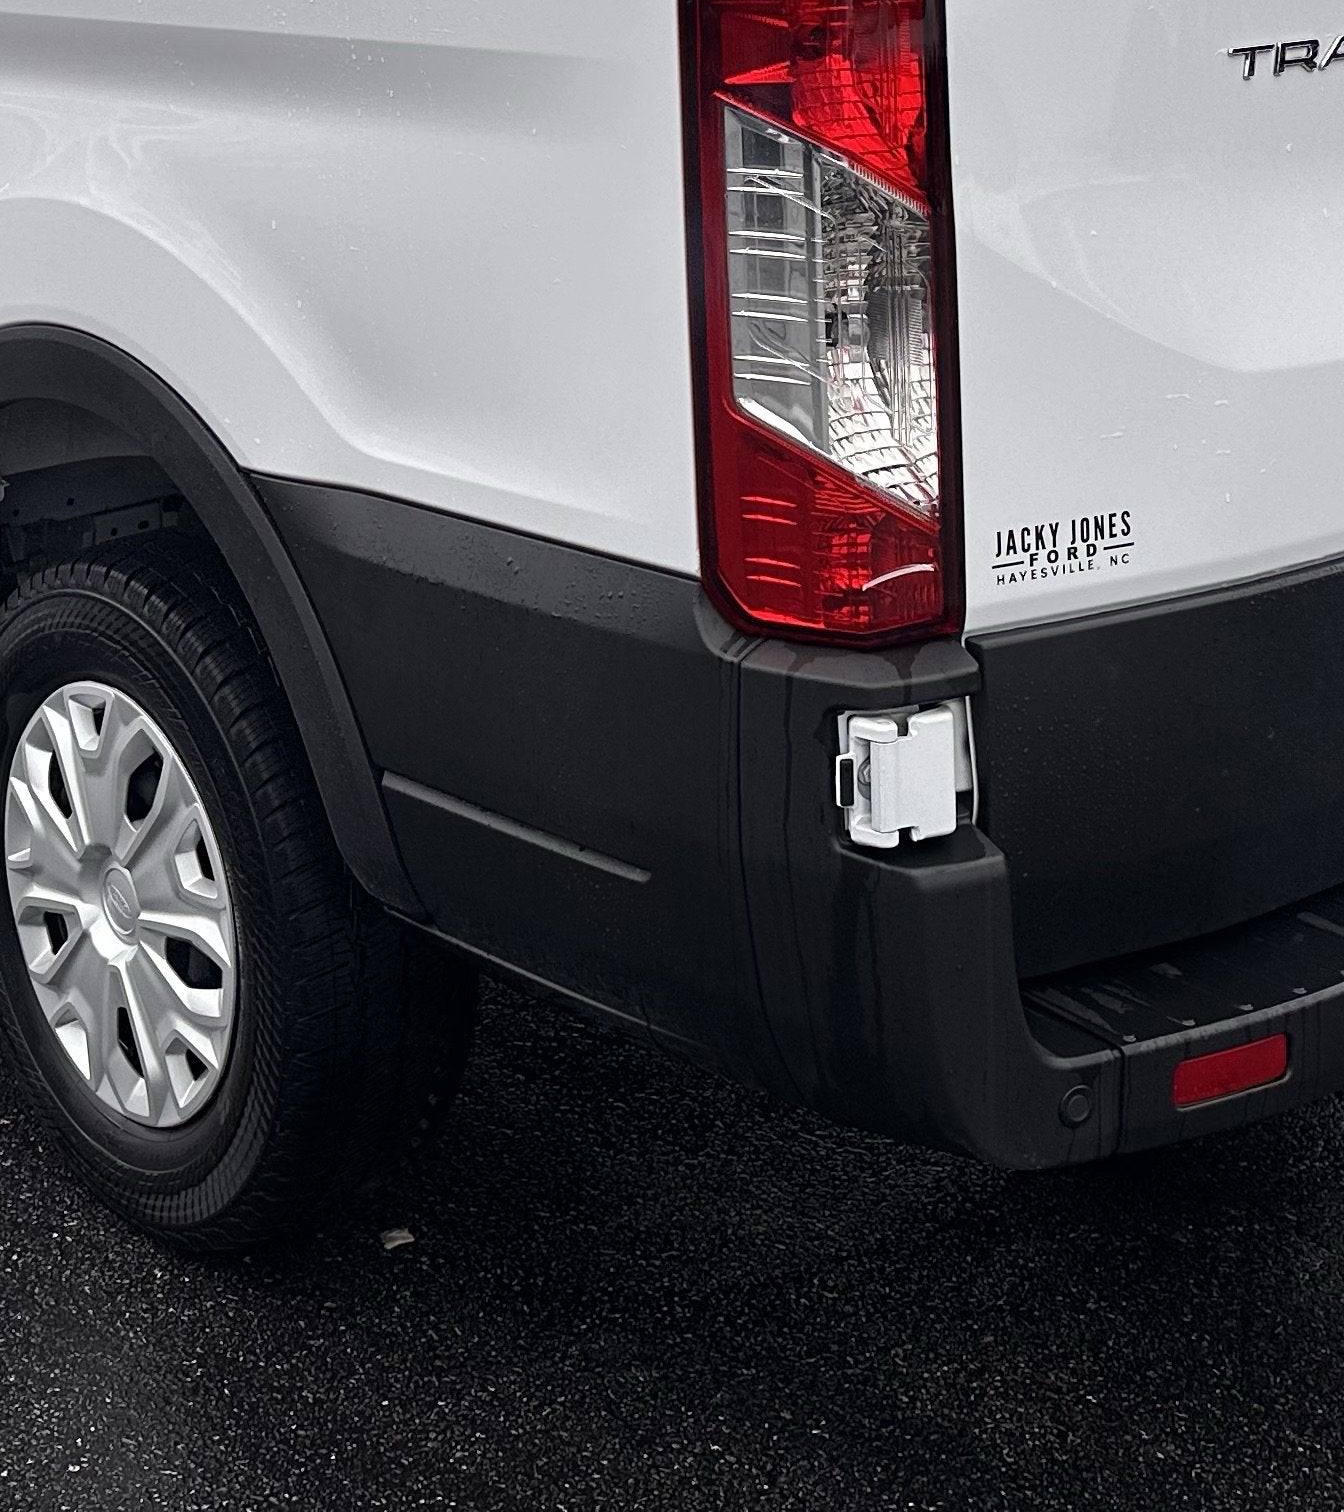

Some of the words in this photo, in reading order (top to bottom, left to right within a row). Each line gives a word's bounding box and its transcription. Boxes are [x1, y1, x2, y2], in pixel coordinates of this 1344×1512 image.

[995, 521, 1060, 558] JACKY
[1070, 510, 1131, 546] JONES
[1029, 543, 1097, 567] FORD
[1109, 553, 1130, 567] NC
